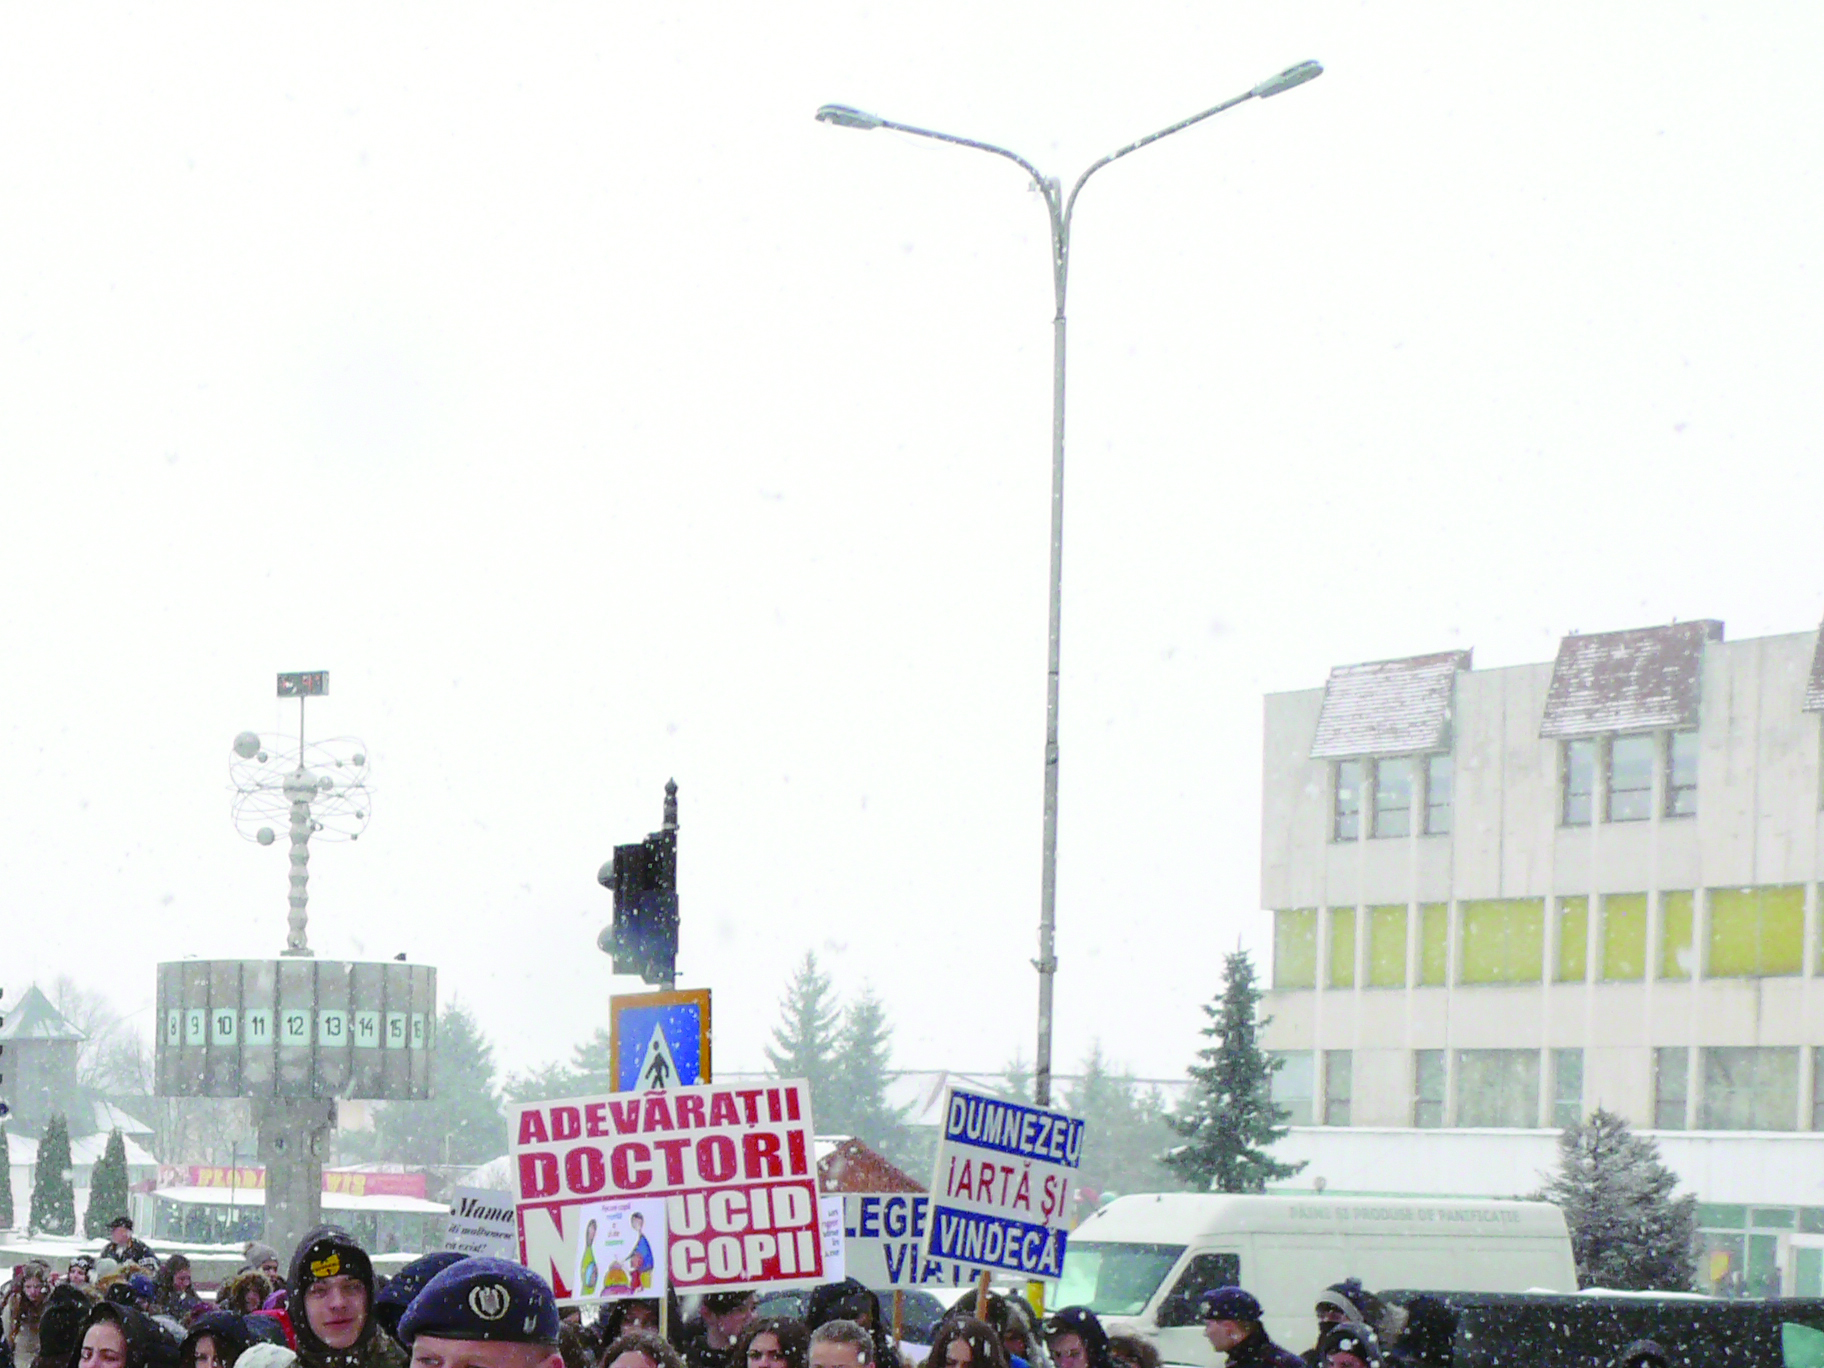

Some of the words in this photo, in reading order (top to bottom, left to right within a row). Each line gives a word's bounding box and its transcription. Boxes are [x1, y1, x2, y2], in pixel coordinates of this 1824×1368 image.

[170, 1017, 177, 1035] 8
[191, 1016, 199, 1035] 9
[217, 1017, 233, 1036] 10
[251, 1017, 265, 1036] 11
[286, 1017, 304, 1036] 12
[325, 1016, 342, 1036] 13
[359, 1017, 374, 1037] 14
[390, 1018, 402, 1038] 15
[948, 1096, 1082, 1165] DUMNEZEU
[517, 1129, 808, 1200] DOCTORI
[947, 1156, 1031, 1212] IARTĂ
[669, 1185, 812, 1236] UCID
[1354, 1207, 1413, 1221] PRODUSE
[1417, 1209, 1434, 1221] DE
[671, 1230, 816, 1283] COPII
[883, 1243, 982, 1288] VIA
[940, 1214, 1060, 1275] VINDECĂ
